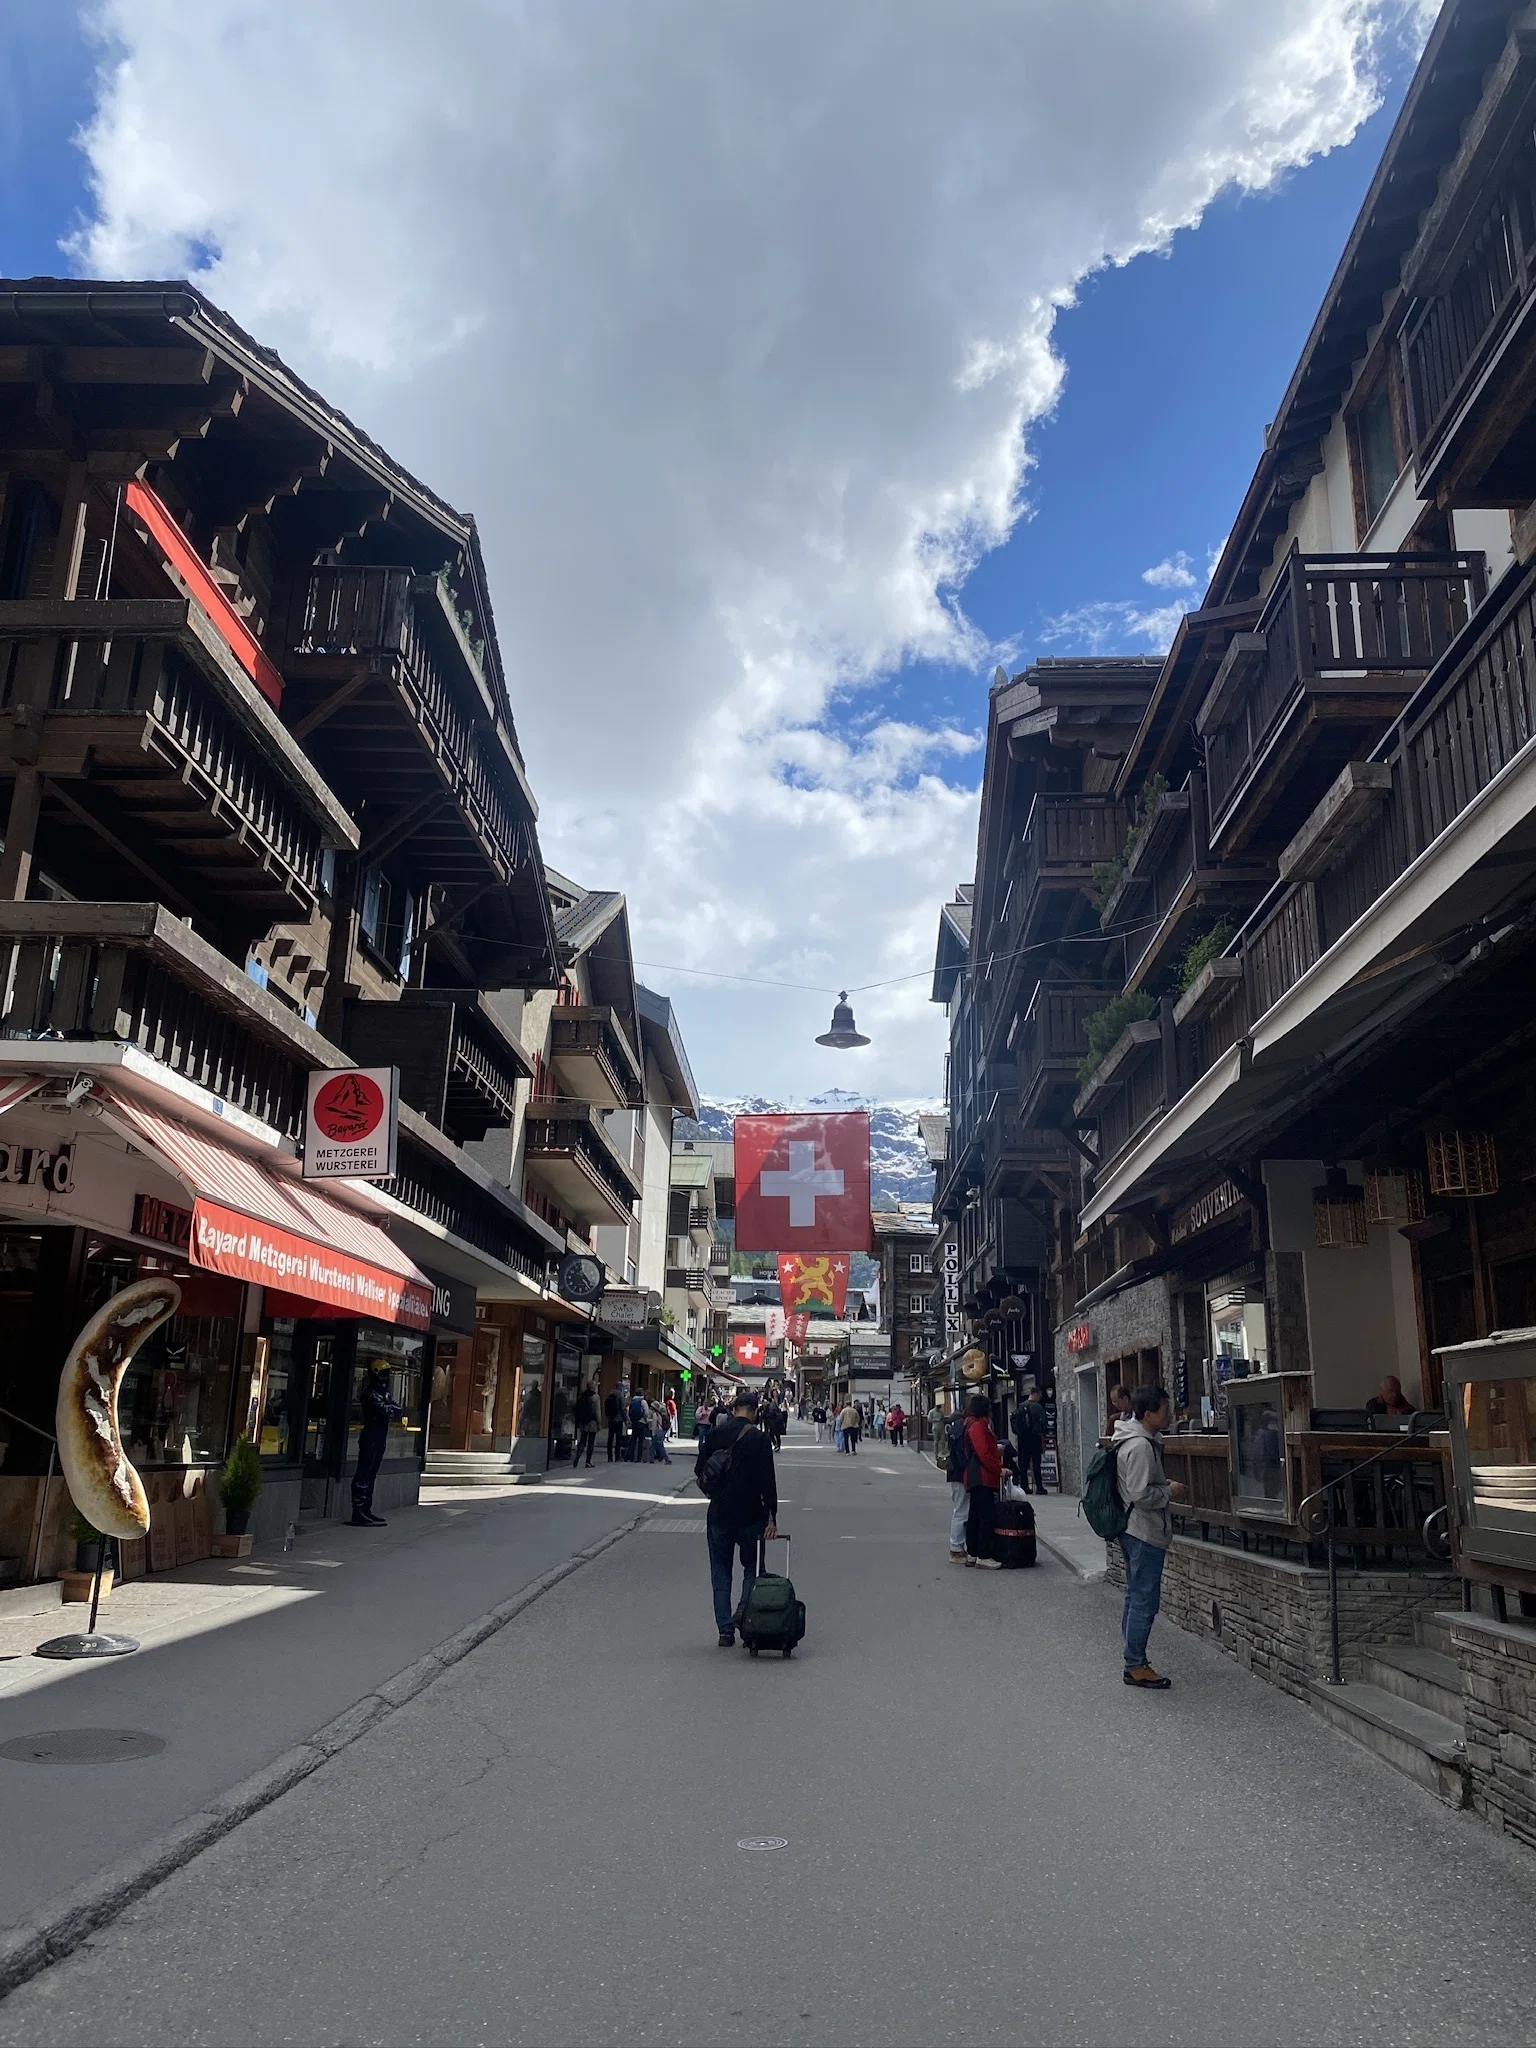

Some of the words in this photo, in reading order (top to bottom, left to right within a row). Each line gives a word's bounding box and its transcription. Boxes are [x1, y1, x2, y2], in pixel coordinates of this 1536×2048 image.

[327, 1119, 368, 1138] Bayard
[316, 1148, 377, 1158] METZGEREI
[316, 1160, 377, 1171] WURSTEREI
[198, 1216, 247, 1258] Bayard
[249, 1235, 308, 1278] Metzgerei
[309, 1257, 355, 1293] Wursterei
[356, 1273, 387, 1303] Walliser
[946, 1244, 958, 1331] POLLUX
[613, 1304, 633, 1312] Swiss
[611, 1311, 634, 1319] Chalet
